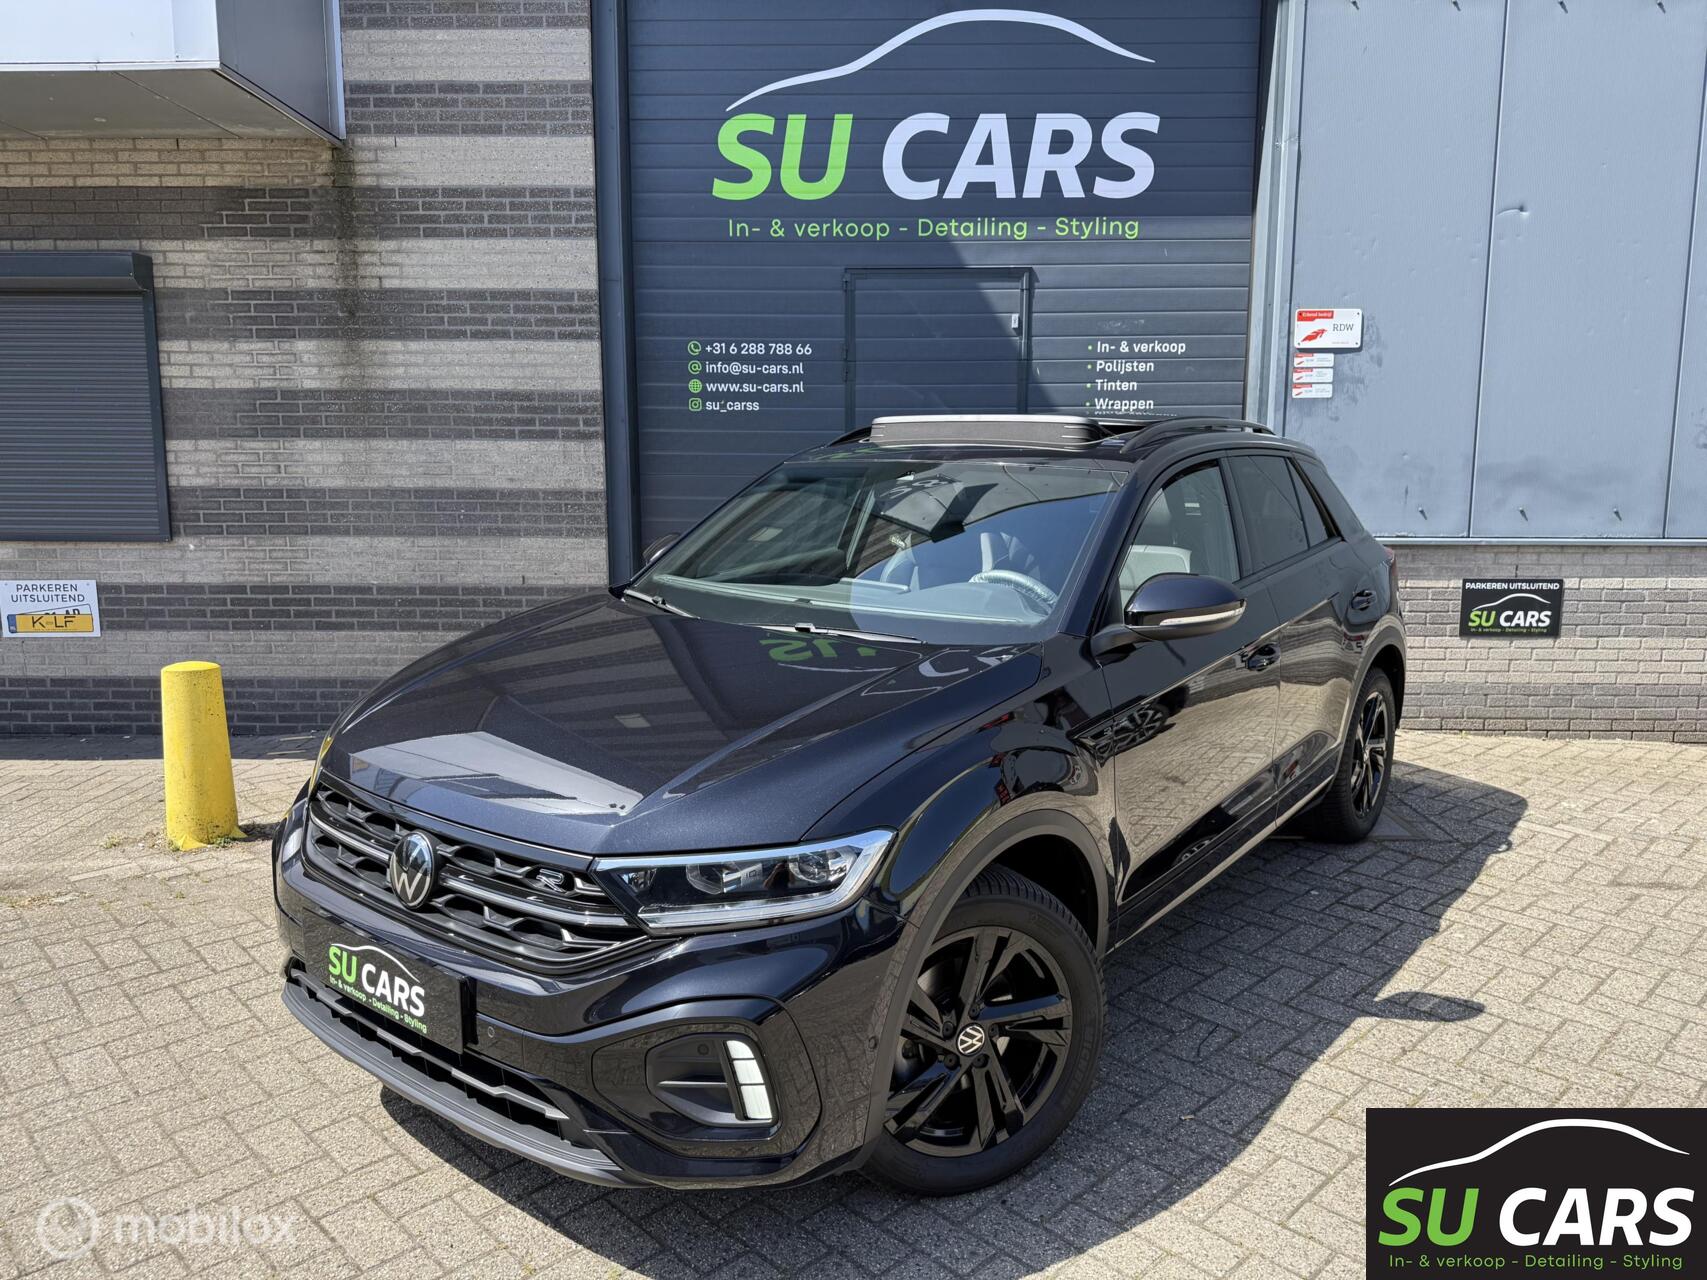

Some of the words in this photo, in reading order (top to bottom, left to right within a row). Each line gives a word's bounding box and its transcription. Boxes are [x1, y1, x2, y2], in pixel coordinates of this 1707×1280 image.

[711, 112, 853, 201] SU
[881, 111, 1161, 201] CARS
[728, 218, 761, 237] In-
[770, 218, 786, 238] &
[795, 217, 890, 240] verkoop
[917, 217, 1028, 240] Detailing
[1055, 216, 1140, 240] Styling
[1332, 323, 1355, 332] RDW
[705, 342, 726, 355] +31
[729, 343, 737, 355] 6
[740, 343, 765, 355] 288
[768, 343, 793, 355] 788
[795, 343, 812, 355] 66
[1096, 341, 1116, 353] In-
[1119, 341, 1130, 353] &
[1133, 340, 1186, 355] verkoop
[705, 361, 804, 376] info@su-cars.nl
[1096, 360, 1154, 374] Polijsten
[705, 381, 805, 393] www.su-cars.nl
[1095, 379, 1138, 391] Tinten
[705, 400, 760, 413] su_carss
[1094, 398, 1154, 412] Wrappen
[16, 583, 78, 592] PARKEREN
[1465, 582, 1508, 590] PARKEREN
[1509, 582, 1560, 590] UITSLUITEND
[11, 594, 85, 602] UITSLUITEND
[1468, 610, 1496, 627] SU
[1499, 610, 1552, 627] CARS
[328, 945, 358, 983] SU
[361, 963, 425, 1018] CARS
